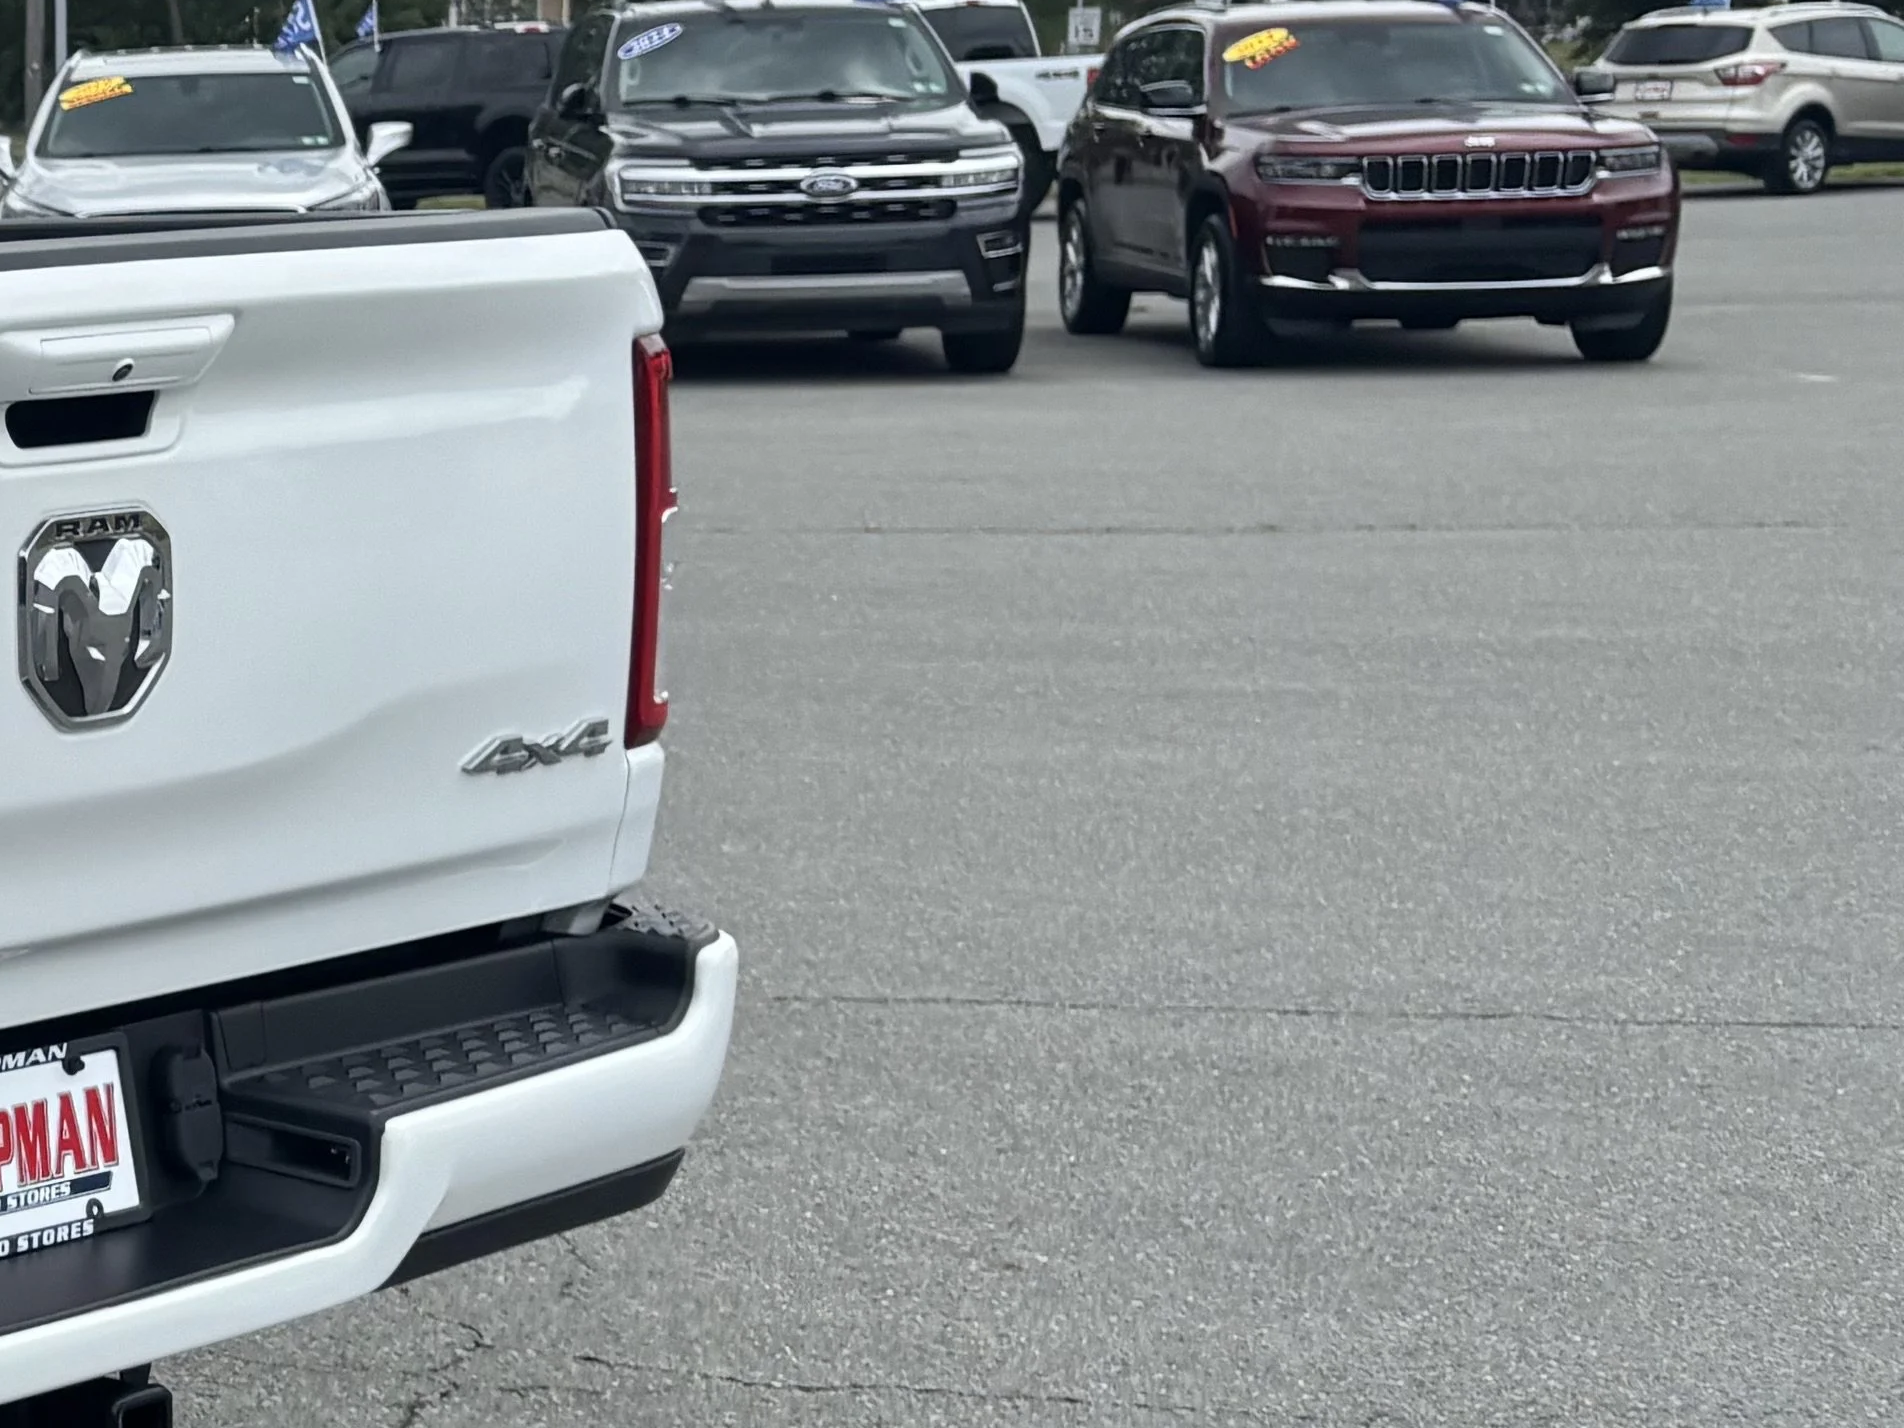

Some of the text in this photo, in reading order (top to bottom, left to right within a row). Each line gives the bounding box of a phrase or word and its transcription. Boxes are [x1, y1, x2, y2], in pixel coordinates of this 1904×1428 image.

[55, 513, 141, 538] RAM
[6, 1181, 72, 1211] STORES
[16, 1218, 95, 1252] STORES
